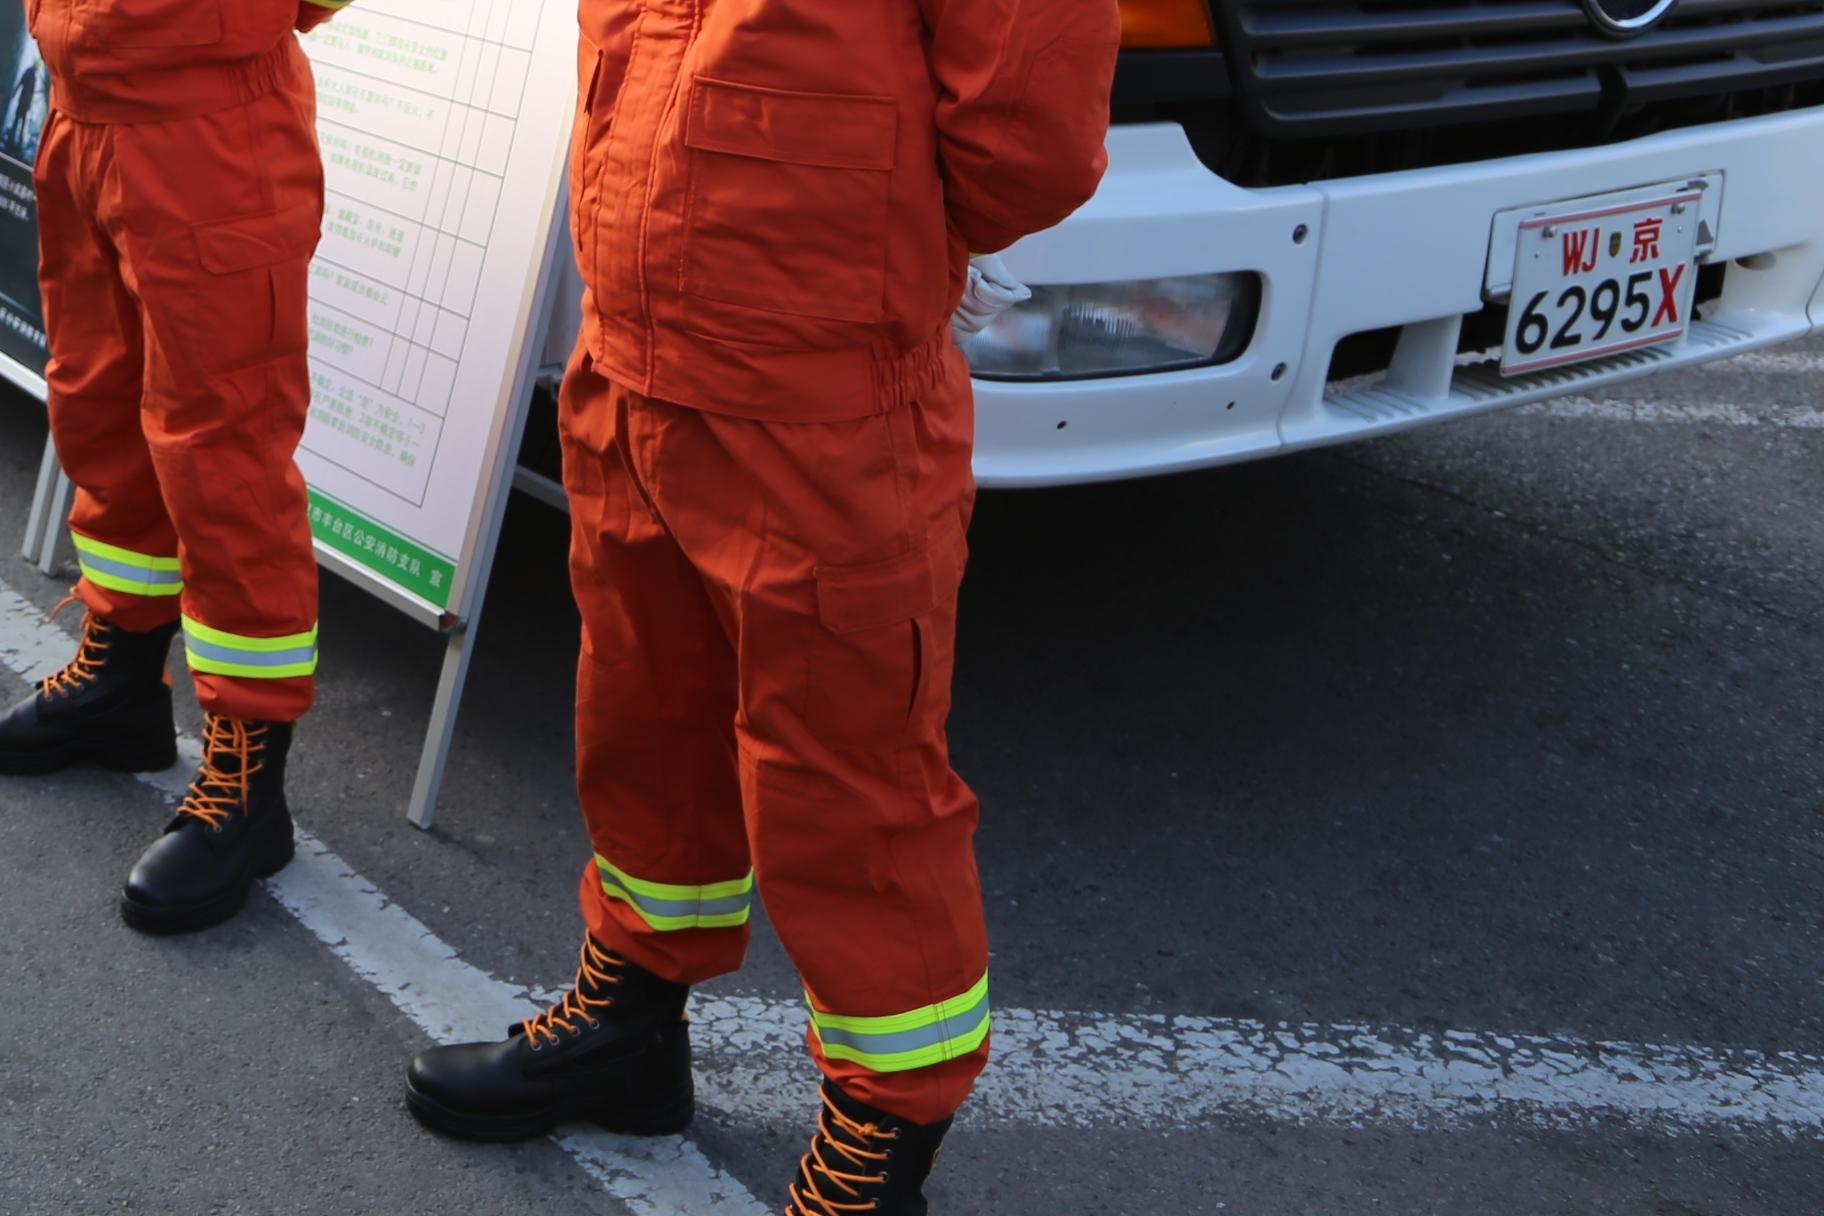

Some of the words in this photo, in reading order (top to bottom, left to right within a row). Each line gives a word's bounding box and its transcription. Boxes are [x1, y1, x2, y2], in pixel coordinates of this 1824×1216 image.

[1562, 228, 1601, 276] WJ
[1630, 217, 1664, 263] 京
[1515, 264, 1686, 354] 6295X
[308, 504, 422, 577] 市丰台区公安消防支队
